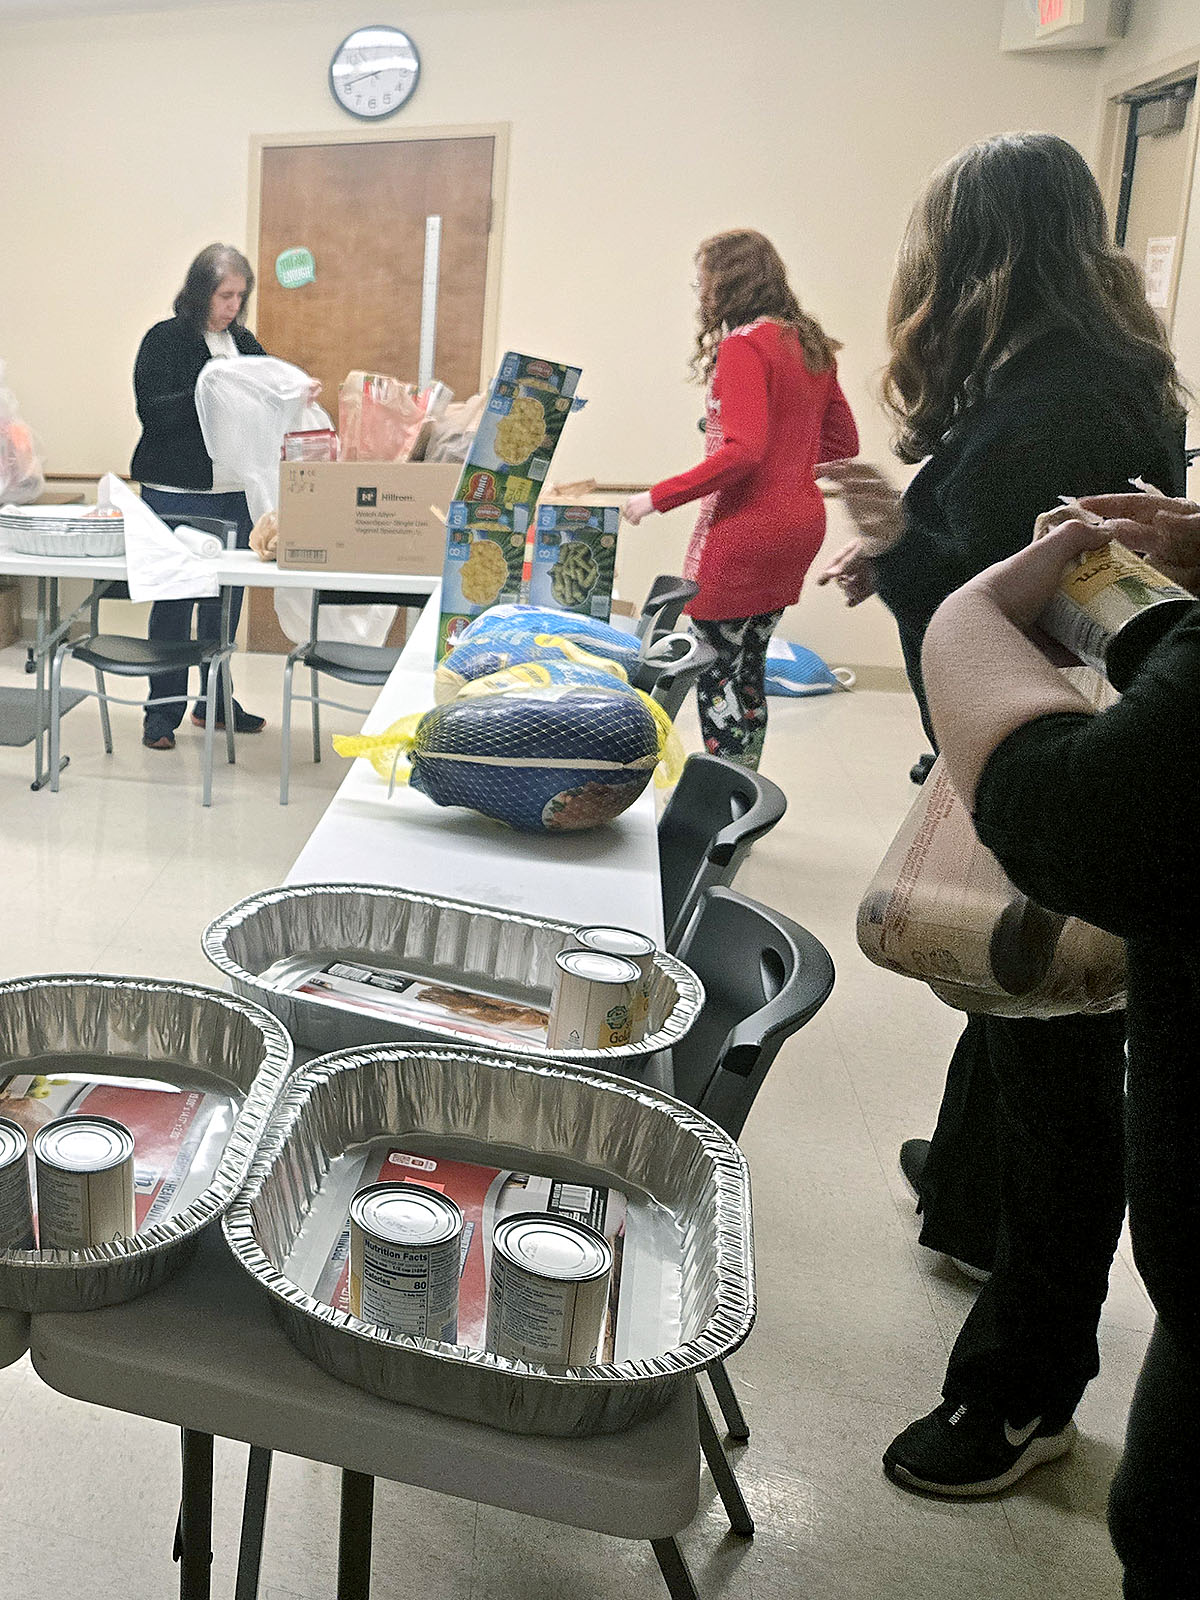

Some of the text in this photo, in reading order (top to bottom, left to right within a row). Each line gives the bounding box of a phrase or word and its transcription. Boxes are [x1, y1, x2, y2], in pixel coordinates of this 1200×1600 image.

[367, 98, 377, 110] 6
[382, 93, 392, 105] 5
[159, 1183, 178, 1204] HEAVY
[365, 1239, 428, 1261] Nutrition Facts
[365, 1269, 427, 1290] Calories 80
[948, 1411, 962, 1426] JUST
